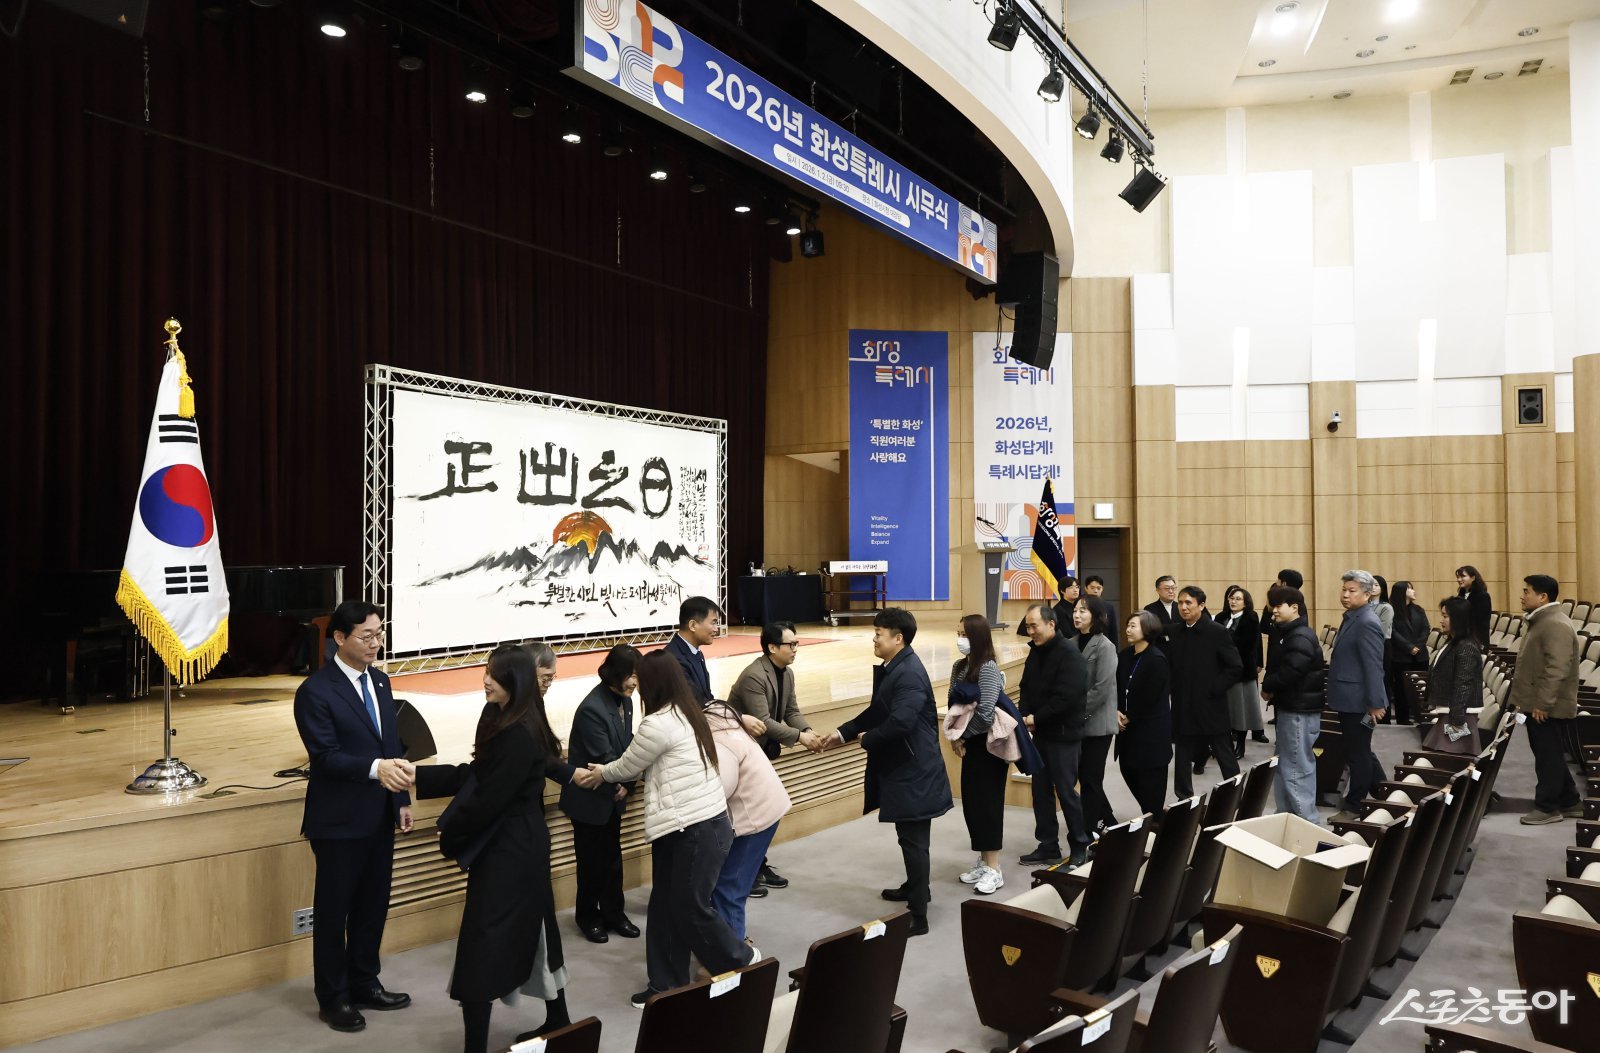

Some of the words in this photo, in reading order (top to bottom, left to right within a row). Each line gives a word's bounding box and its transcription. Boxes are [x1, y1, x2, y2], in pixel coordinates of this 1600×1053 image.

[705, 60, 804, 147] 2026년
[810, 120, 901, 202] 화성특례시
[905, 181, 949, 231] 시무식
[862, 340, 900, 364] 화성
[995, 416, 1052, 432] 2026년,
[869, 435, 915, 447] 직원여러분
[994, 440, 1054, 455] 화성답게!
[869, 451, 907, 463] 사랑해요
[988, 464, 1061, 480] 특례시답게!
